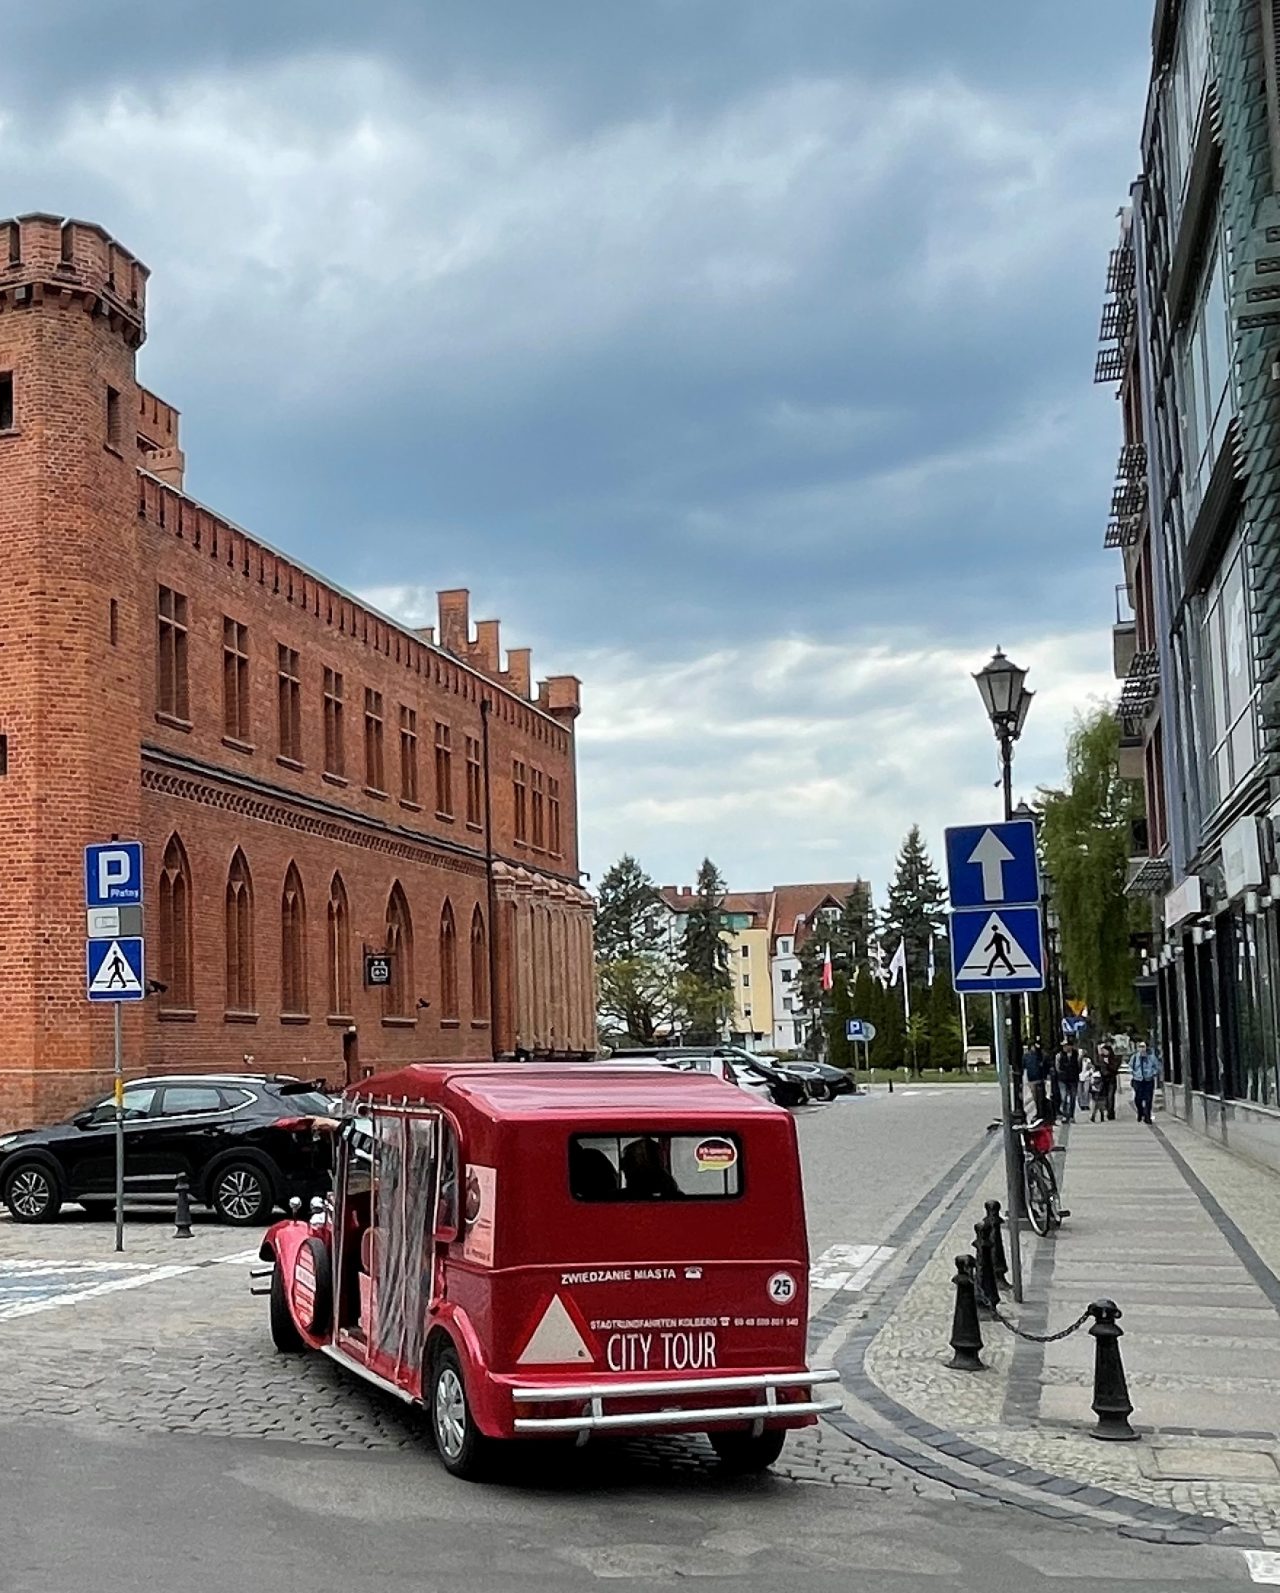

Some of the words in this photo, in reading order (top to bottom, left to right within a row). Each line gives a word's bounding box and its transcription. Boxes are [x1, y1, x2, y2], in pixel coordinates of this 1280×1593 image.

[99, 850, 130, 899] P
[850, 1020, 860, 1034] P
[561, 1269, 632, 1285] ZWIEDZANIE
[634, 1268, 677, 1280] MIASTA
[773, 1279, 791, 1296] 25
[590, 1317, 677, 1330] STADTRUNDFAHRTEN
[678, 1317, 718, 1327] KOLBERG
[607, 1332, 652, 1372] CITY
[660, 1331, 717, 1370] TOUR
